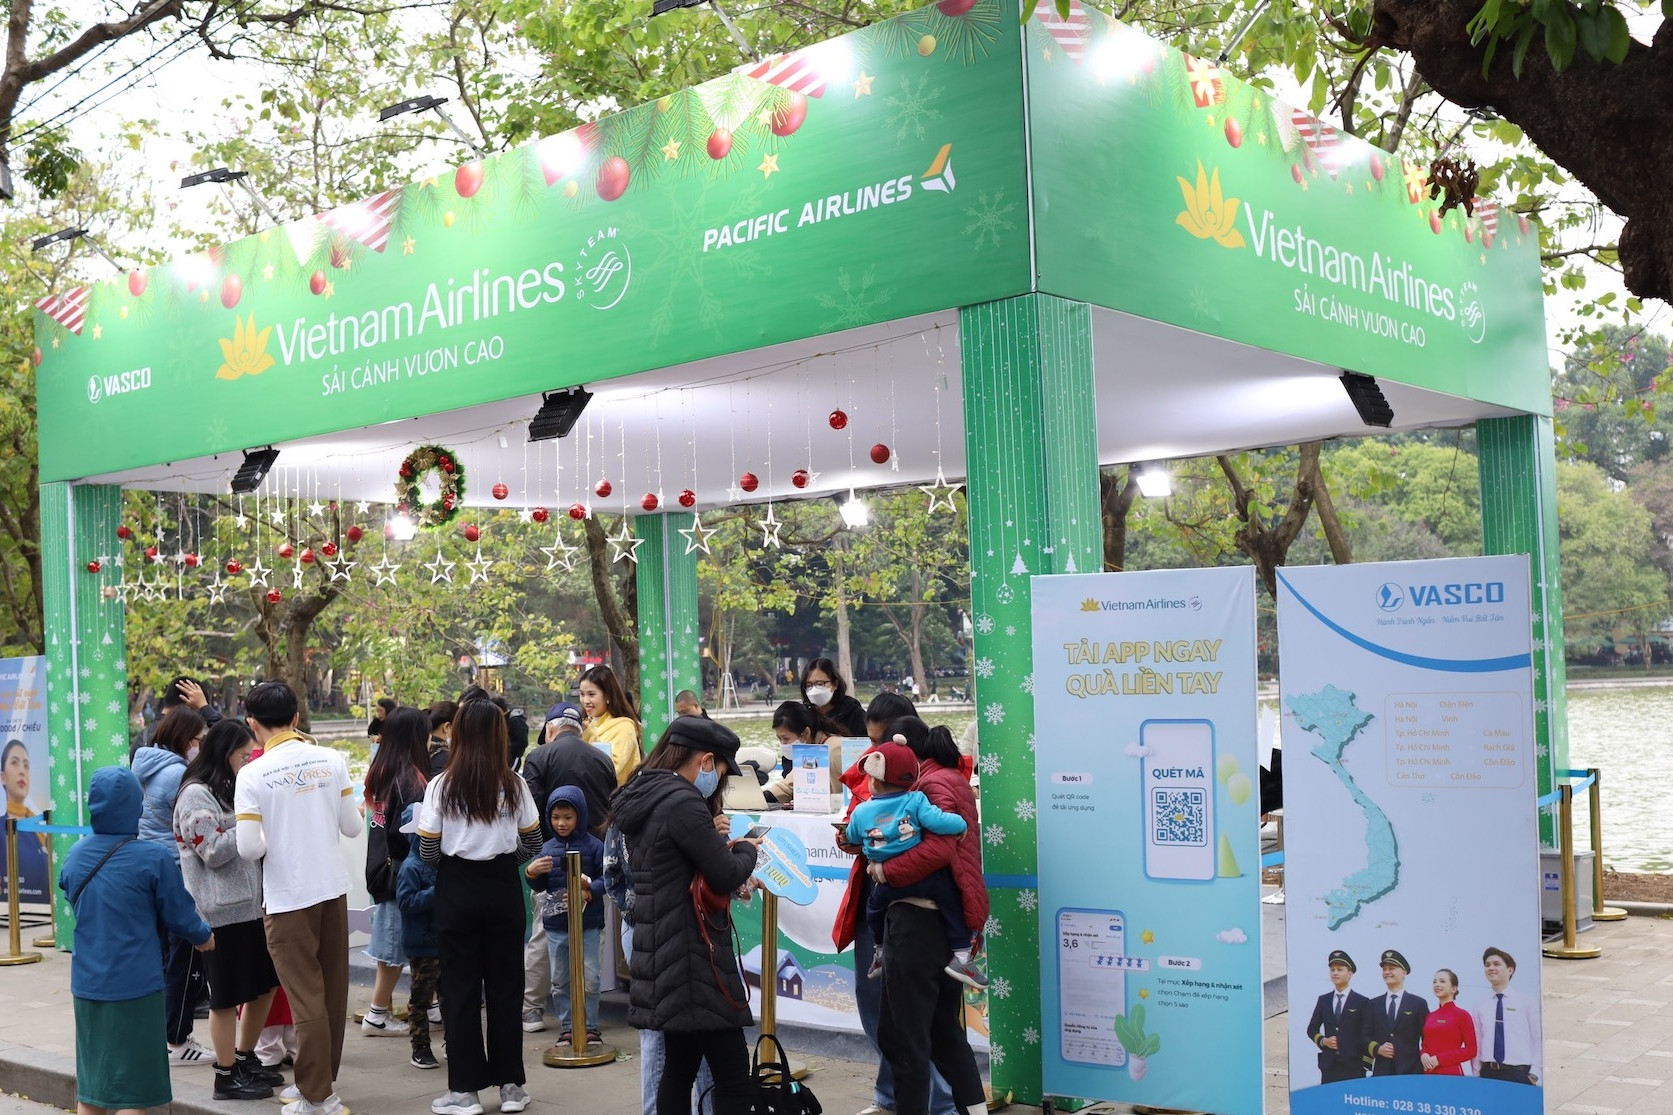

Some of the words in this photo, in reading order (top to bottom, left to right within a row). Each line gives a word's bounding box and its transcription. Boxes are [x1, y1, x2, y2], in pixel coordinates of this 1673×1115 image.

[703, 209, 789, 252] PACIFIC
[797, 175, 912, 227] AIRLINES
[575, 227, 617, 299] SKYTEAM
[1244, 201, 1366, 291] Vietnam
[1369, 252, 1456, 321] Airlines
[275, 301, 413, 366] Vietnam
[417, 261, 565, 334] Airlines
[1294, 283, 1315, 316] SẢI
[1320, 295, 1358, 328] CÁNH
[1401, 322, 1425, 347] CAO
[103, 367, 151, 397] VASCO
[322, 365, 346, 396] SẢI
[351, 359, 399, 389] CÁNH
[464, 336, 504, 365] CAO
[1409, 582, 1504, 607] VASCO
[1064, 638, 1099, 664] TẢI
[1103, 642, 1150, 664] APP
[1154, 639, 1222, 662] NGAY
[1066, 669, 1118, 698] QUÀ
[1123, 666, 1173, 695] LIỀN
[1176, 672, 1223, 694] TAY
[1152, 767, 1183, 781] QUÉT
[1185, 766, 1204, 779] MÃ
[1063, 938, 1078, 949] 3,6
[1344, 1093, 1389, 1109] Hotline:
[1393, 1099, 1414, 1111] 028
[1417, 1102, 1431, 1113] 38
[1434, 1104, 1456, 1115] 330
[1460, 1106, 1481, 1115] 330
